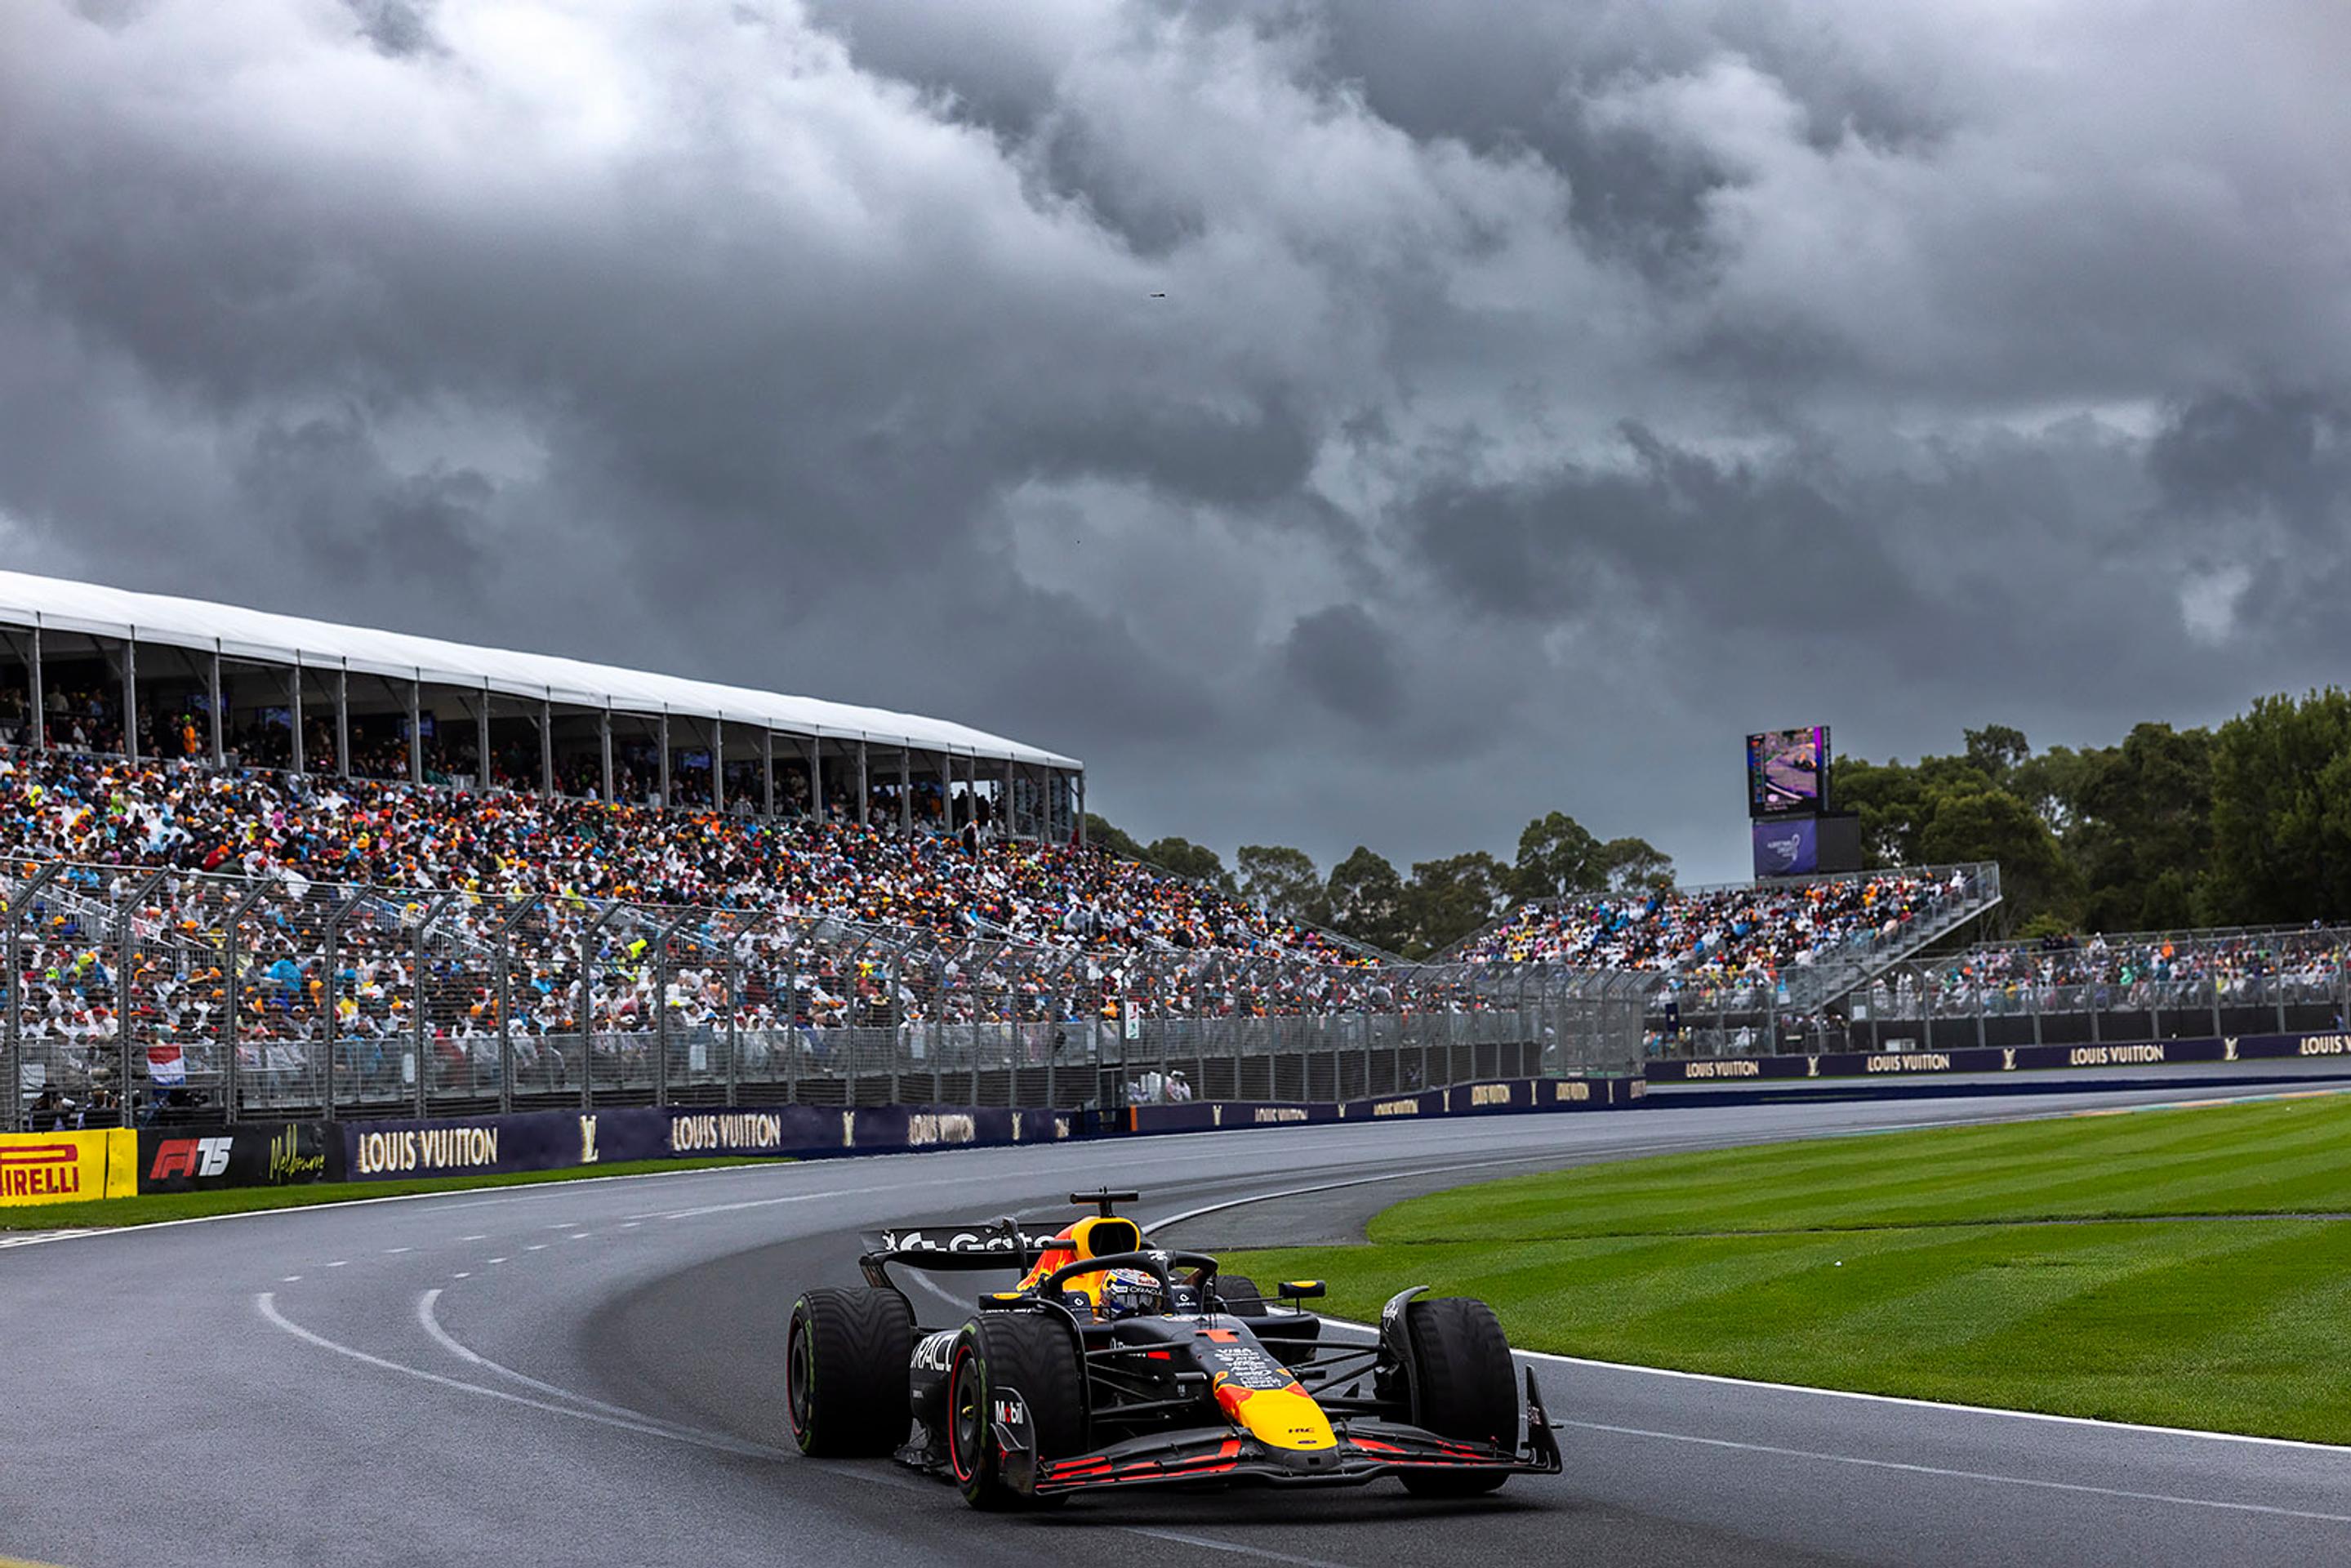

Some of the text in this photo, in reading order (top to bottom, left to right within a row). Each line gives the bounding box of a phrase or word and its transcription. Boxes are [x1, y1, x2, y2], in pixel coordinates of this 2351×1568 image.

[2071, 1045, 2164, 1065] LOUIS VUITTON
[2301, 1033, 2342, 1055] LOUIS
[1685, 1061, 1760, 1078] LOUIS VUITTON
[1868, 1054, 1950, 1072] LOUIS VUITTON
[672, 1113, 781, 1151] LOUIS VUITTON
[269, 1124, 325, 1184] Melbourne
[358, 1127, 498, 1174] LOUIS VUITTON
[995, 1400, 1024, 1424] Mobil
